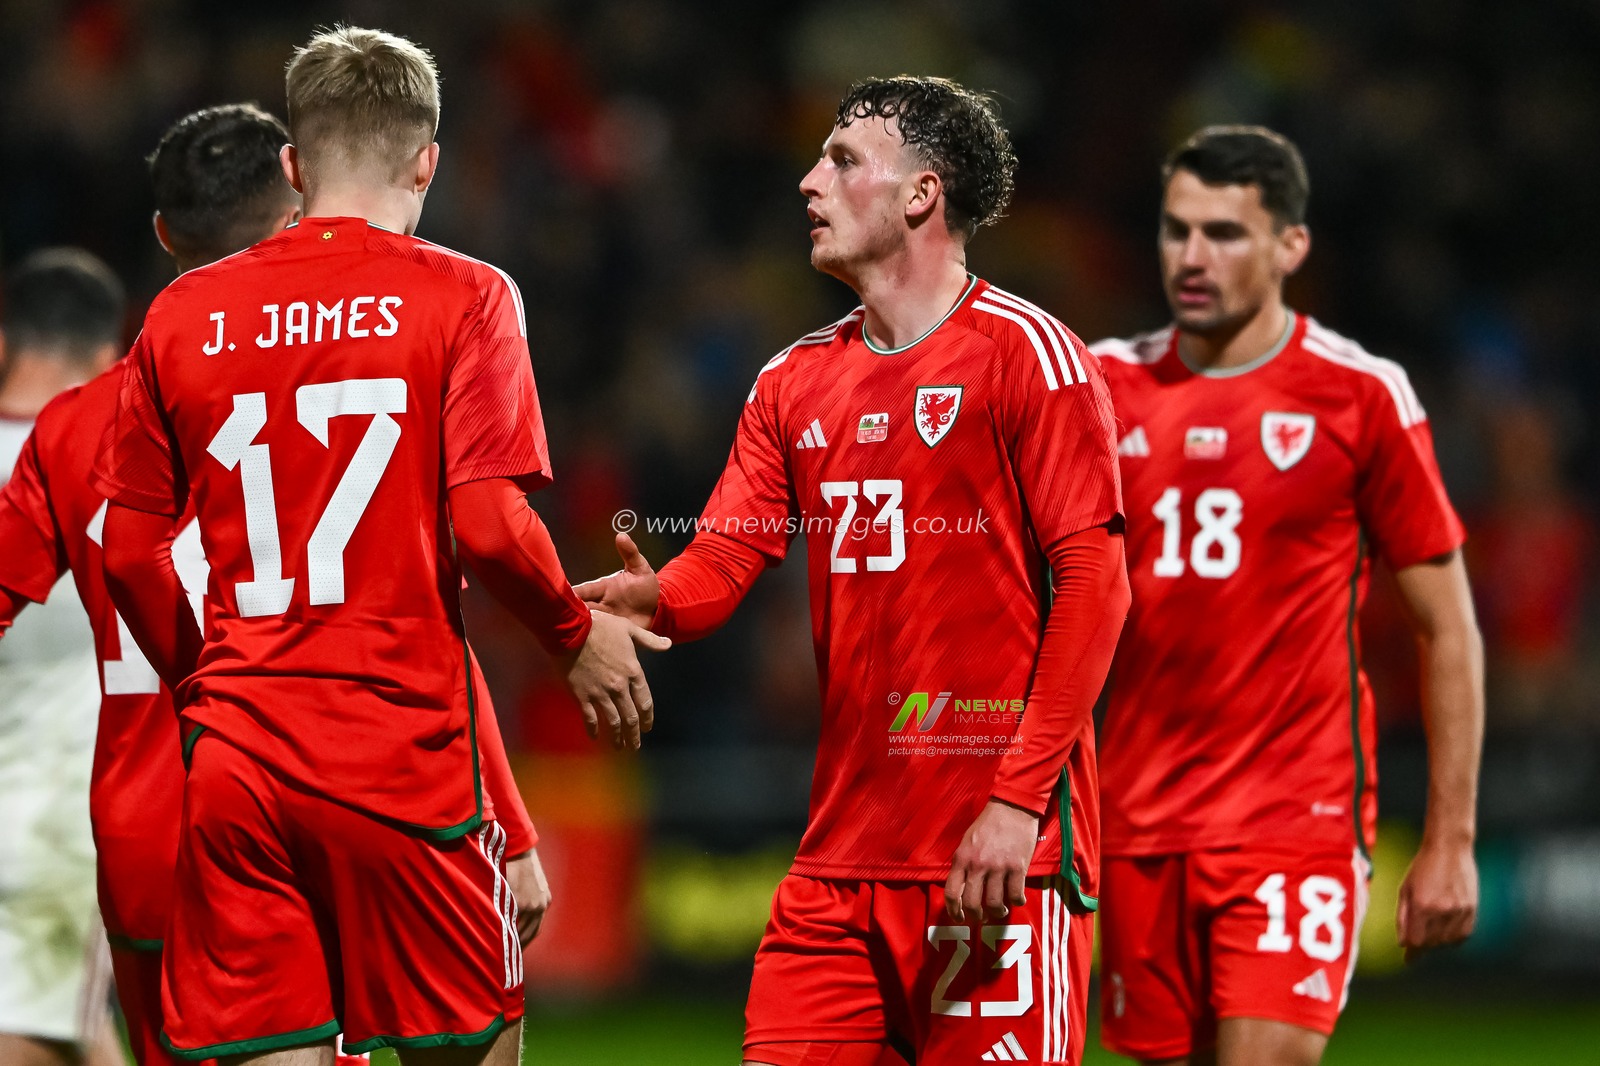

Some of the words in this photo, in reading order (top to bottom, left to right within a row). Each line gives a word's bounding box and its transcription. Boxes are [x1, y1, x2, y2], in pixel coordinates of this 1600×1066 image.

[202, 311, 237, 356] J.
[255, 296, 403, 349] JAMES
[206, 377, 408, 618] 17
[820, 479, 906, 573] 23
[1152, 486, 1244, 579] 18
[1254, 873, 1355, 962] 18
[928, 924, 1034, 1018] 23
